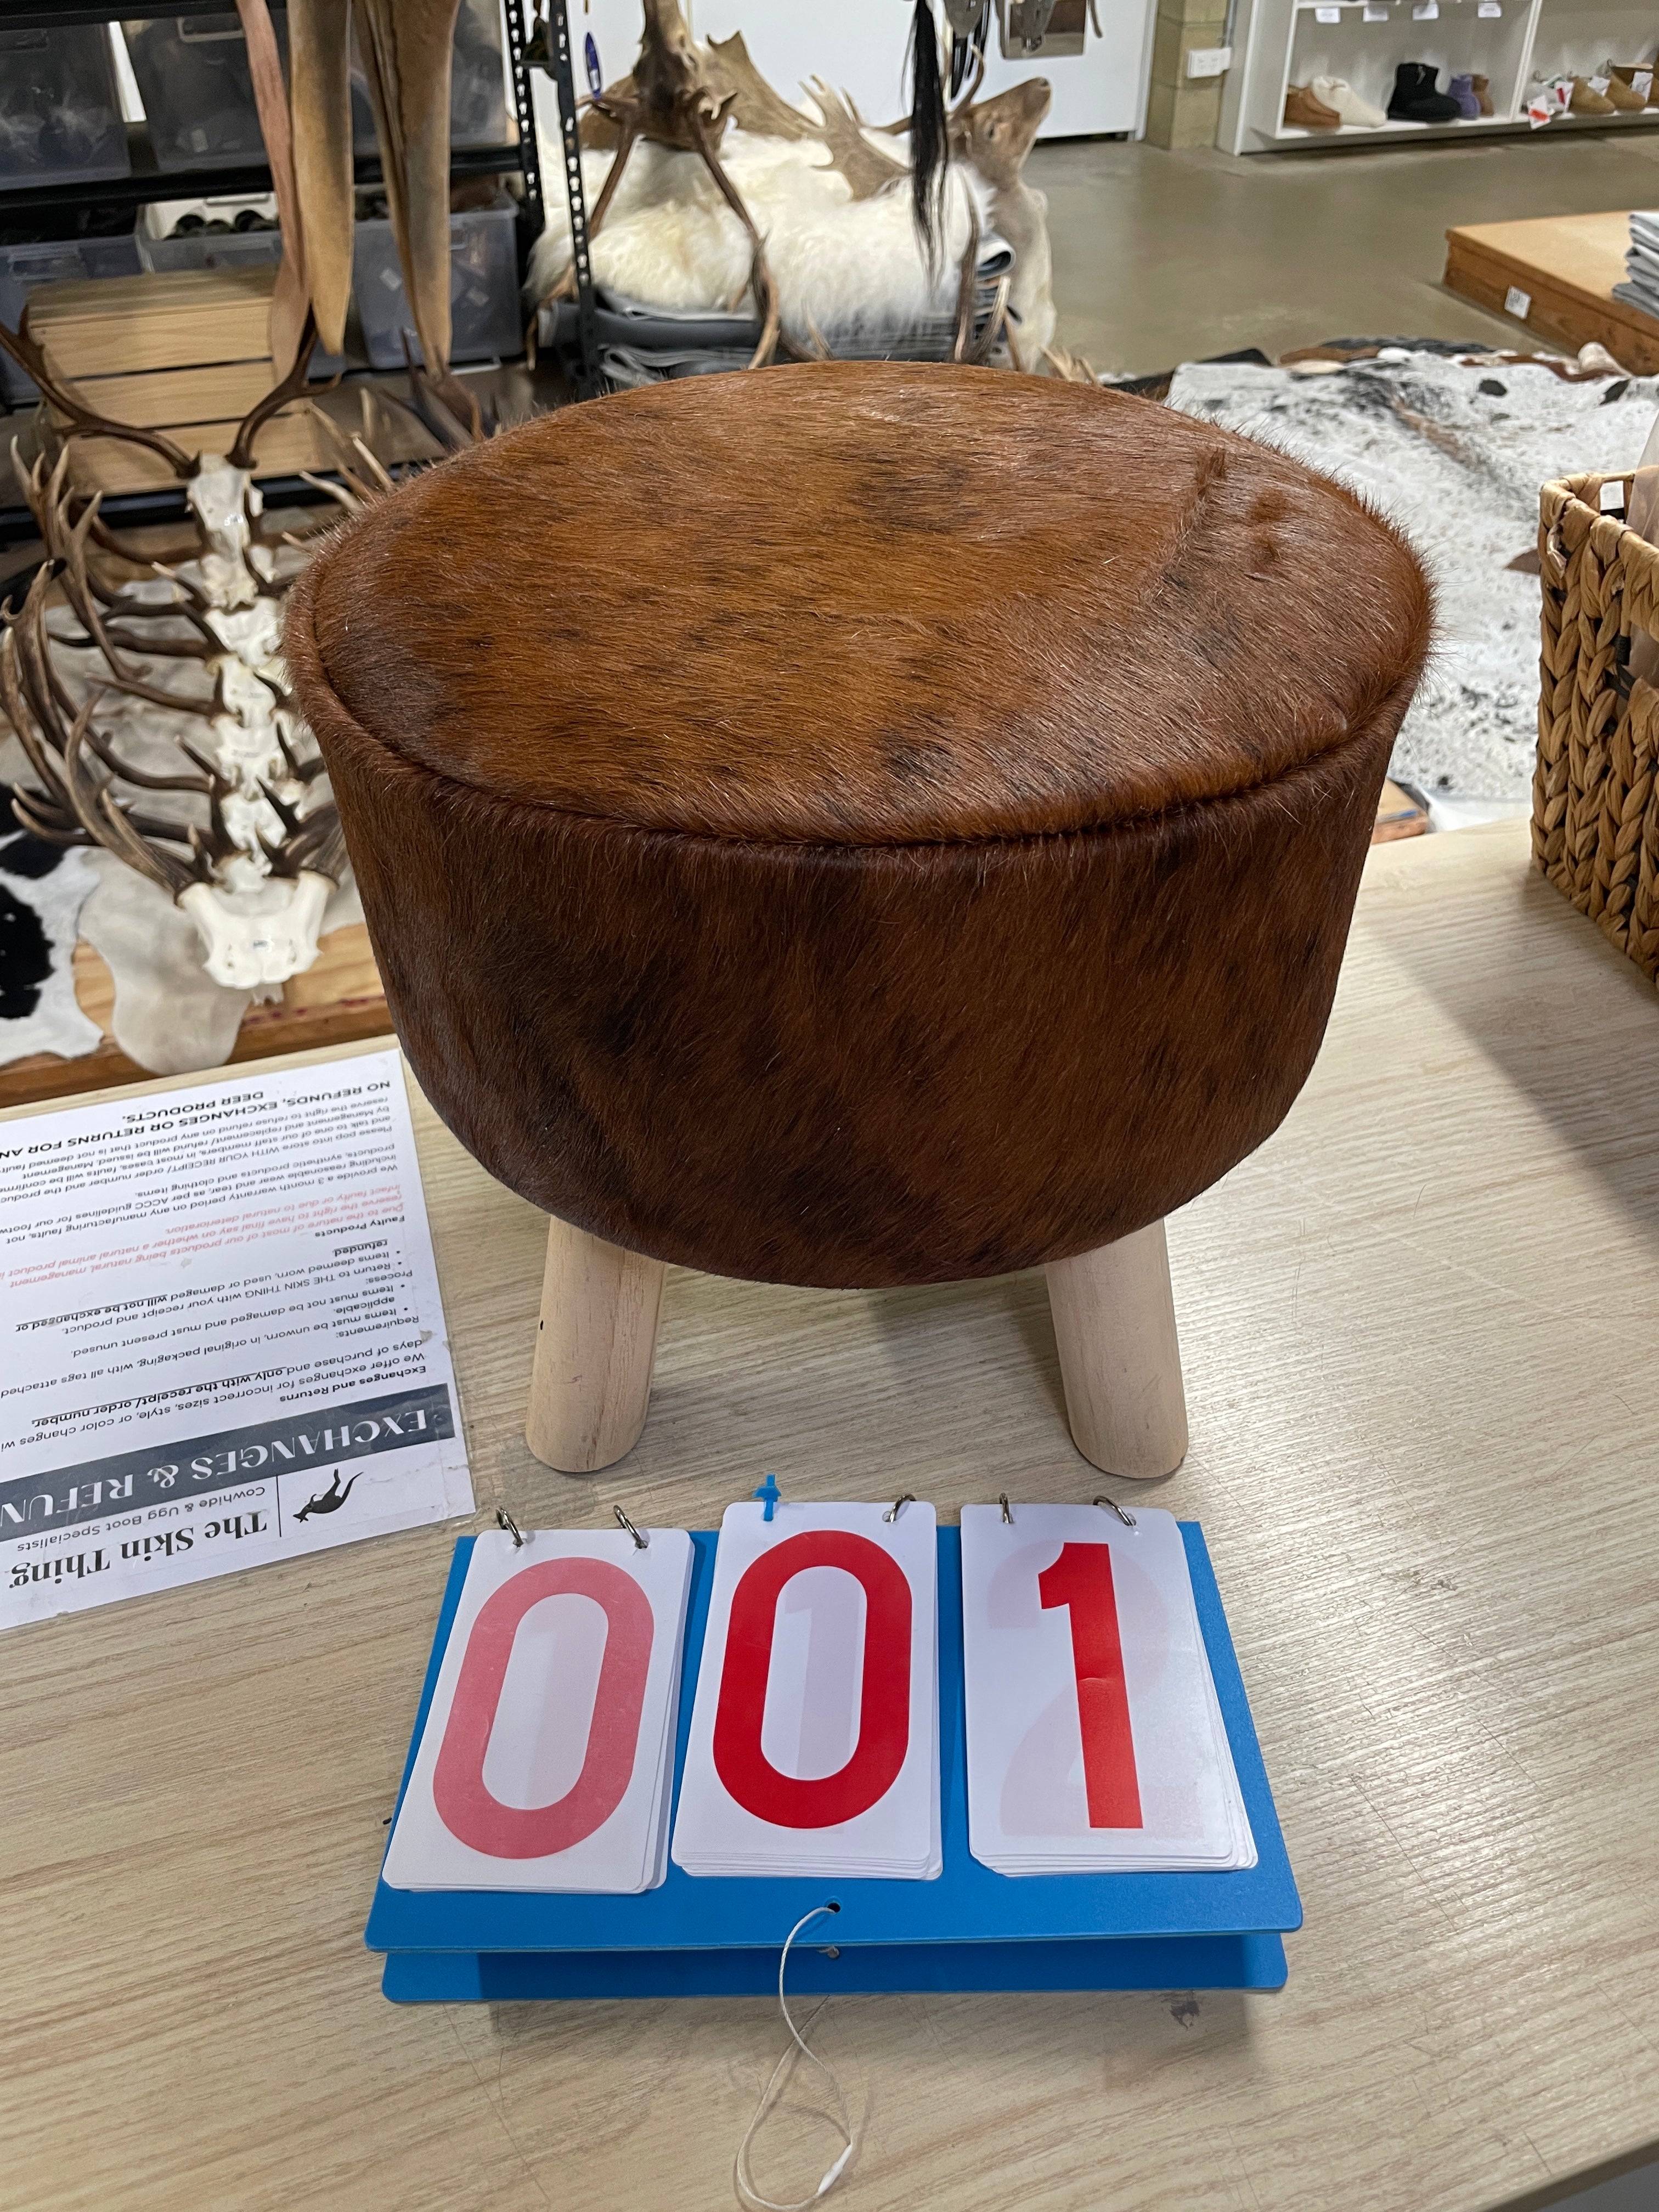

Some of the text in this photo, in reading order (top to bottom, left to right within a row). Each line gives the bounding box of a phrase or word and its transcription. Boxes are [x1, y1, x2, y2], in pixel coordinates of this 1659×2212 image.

[366, 1081, 390, 1091] NO
[221, 1091, 263, 1105] DEER
[178, 1101, 278, 1126] EXCHANGES
[149, 1120, 174, 1132] OR
[358, 1125, 392, 1136] Please
[67, 1125, 145, 1147] RETURNS
[312, 1136, 332, 1144] into
[335, 1130, 356, 1139] pop
[27, 1140, 62, 1154] FOR
[251, 1146, 280, 1157] WITH
[281, 1140, 309, 1150] store
[218, 1151, 249, 1163] YOUR
[349, 1154, 396, 1167] including
[133, 1167, 164, 1178] order
[287, 1163, 346, 1179] reasonable
[336, 1166, 377, 1180] provide
[380, 1164, 398, 1172] We
[88, 1173, 132, 1187] number
[235, 1180, 256, 1190] and
[258, 1174, 285, 1184] wear
[279, 1178, 314, 1191] month
[43, 1186, 61, 1195] the
[64, 1182, 86, 1193] and
[228, 1186, 276, 1201] warranty
[171, 1190, 190, 1201] per
[189, 1194, 226, 1210] period
[134, 1196, 168, 1210] ACCC
[75, 1201, 132, 1220] guidelines
[149, 1206, 170, 1216] any
[34, 1218, 53, 1228] our
[55, 1215, 72, 1223] for
[65, 1211, 147, 1232] manufacturing
[314, 1215, 405, 1237] Faulty Products
[6, 1234, 25, 1244] not
[358, 1251, 389, 1262] Items
[308, 1257, 355, 1274] deemed
[353, 1262, 391, 1274] Return
[228, 1280, 240, 1289] or
[243, 1274, 272, 1287] used
[284, 1278, 310, 1290] SKIN
[313, 1273, 336, 1284] THE
[170, 1284, 225, 1302] damaged
[244, 1284, 280, 1298] THING
[362, 1284, 393, 1296] Items
[146, 1293, 167, 1307] will
[187, 1296, 214, 1308] your
[216, 1292, 242, 1304] with
[307, 1299, 326, 1308] not
[329, 1291, 358, 1304] must
[103, 1303, 120, 1313] be
[122, 1298, 144, 1311] not
[142, 1304, 184, 1318] receipt
[115, 1313, 138, 1325] and
[230, 1307, 285, 1325] damaged
[15, 1322, 29, 1333] or
[171, 1324, 201, 1336] must
[204, 1319, 227, 1330] and
[121, 1329, 168, 1347] present
[0, 1308, 397, 1399] Items must be unworn, in original packaging, with all tags attached
[71, 1341, 118, 1358] unused.
[370, 1357, 400, 1370] offer
[403, 1352, 425, 1362] We
[298, 1364, 366, 1385] exchanges
[31, 1339, 422, 1427] days of purchase and only with the receipt/ order number.
[276, 1380, 295, 1390] for
[279, 1365, 426, 1402] Exchanges and Returns
[213, 1384, 273, 1403] incorrect
[174, 1398, 210, 1410] sizes,
[118, 1414, 132, 1424] or
[136, 1406, 171, 1419] style,
[80, 1418, 115, 1432] color
[19, 1426, 76, 1445] changes
[0, 1409, 426, 1527] EXCHANGES & REFUN
[17, 1486, 266, 1551] Cowhide & Ugg Boot Specialists
[8, 1510, 267, 1589] The Skin Thing
